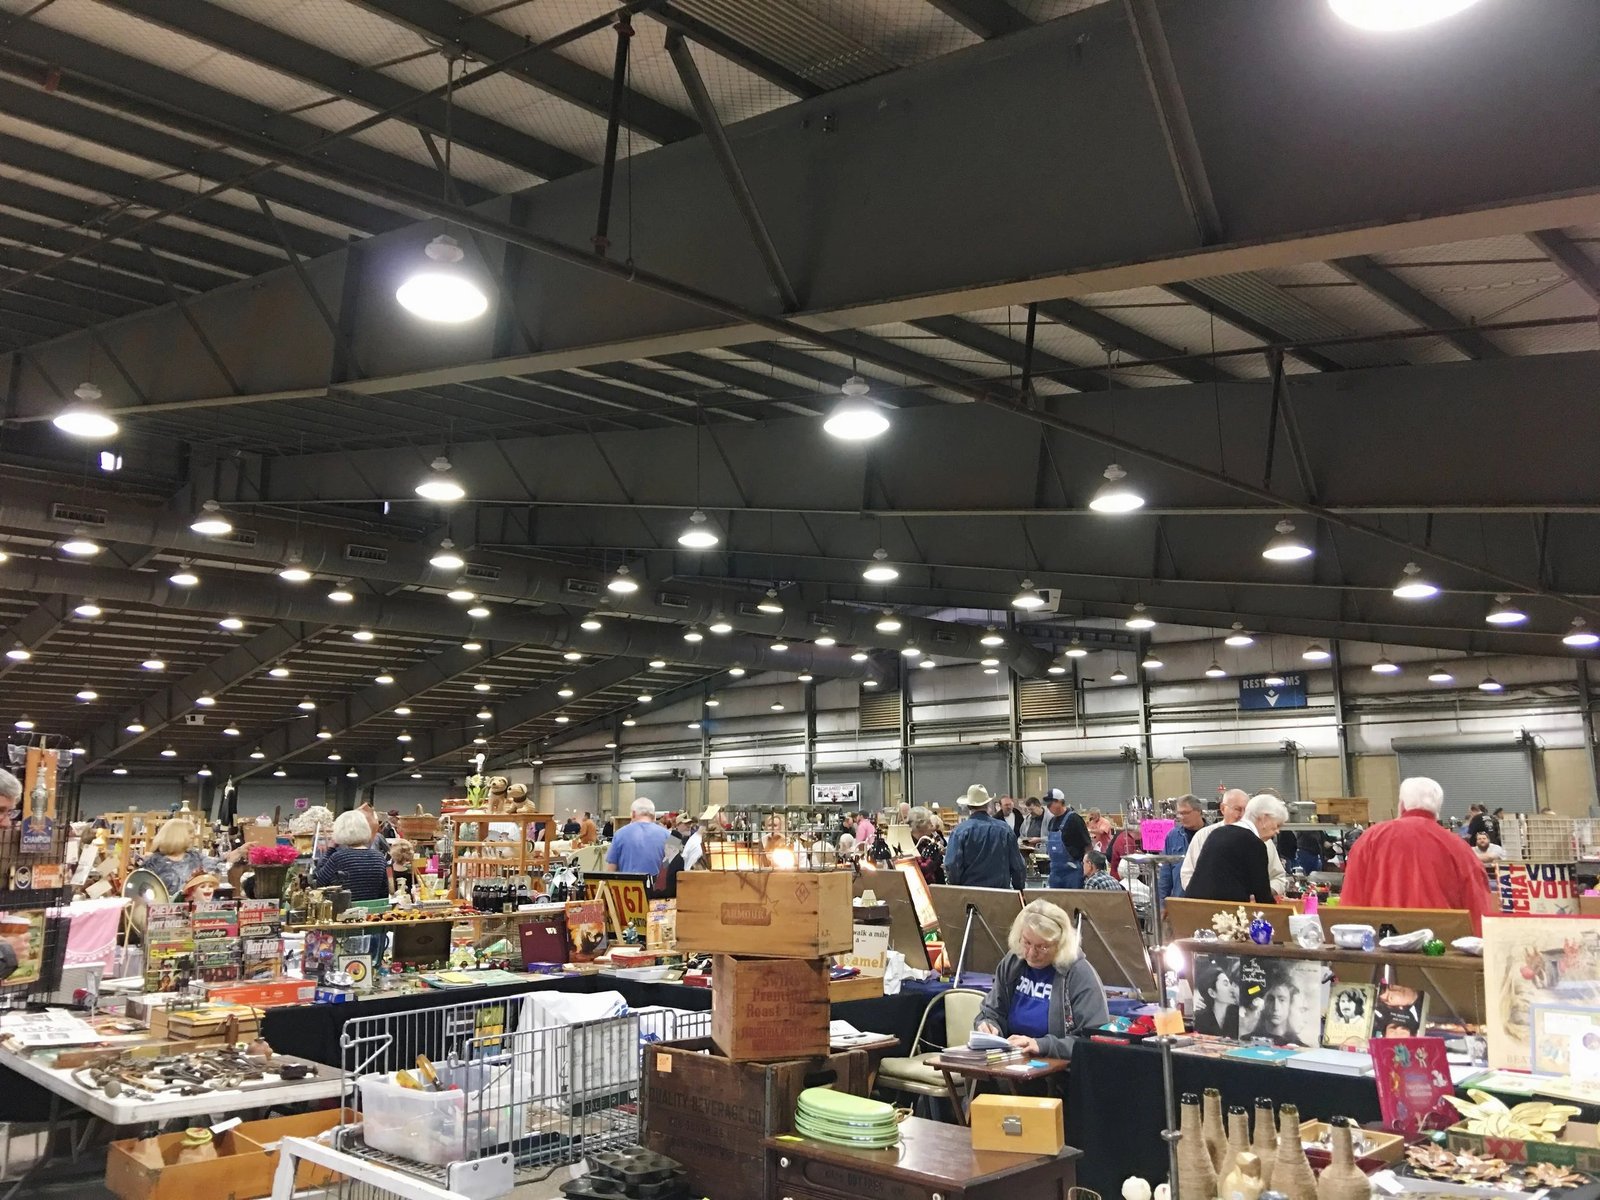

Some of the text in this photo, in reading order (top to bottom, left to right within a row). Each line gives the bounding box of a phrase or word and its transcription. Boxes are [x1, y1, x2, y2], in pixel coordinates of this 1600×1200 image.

[1243, 676, 1300, 688] RESTMS
[23, 835, 50, 844] CHAMPION
[1525, 864, 1577, 881] VOTE
[1527, 881, 1578, 898] VOTE
[723, 909, 765, 920] ARMOUR
[746, 1003, 781, 1018] Roast
[1484, 1135, 1528, 1163] XX
